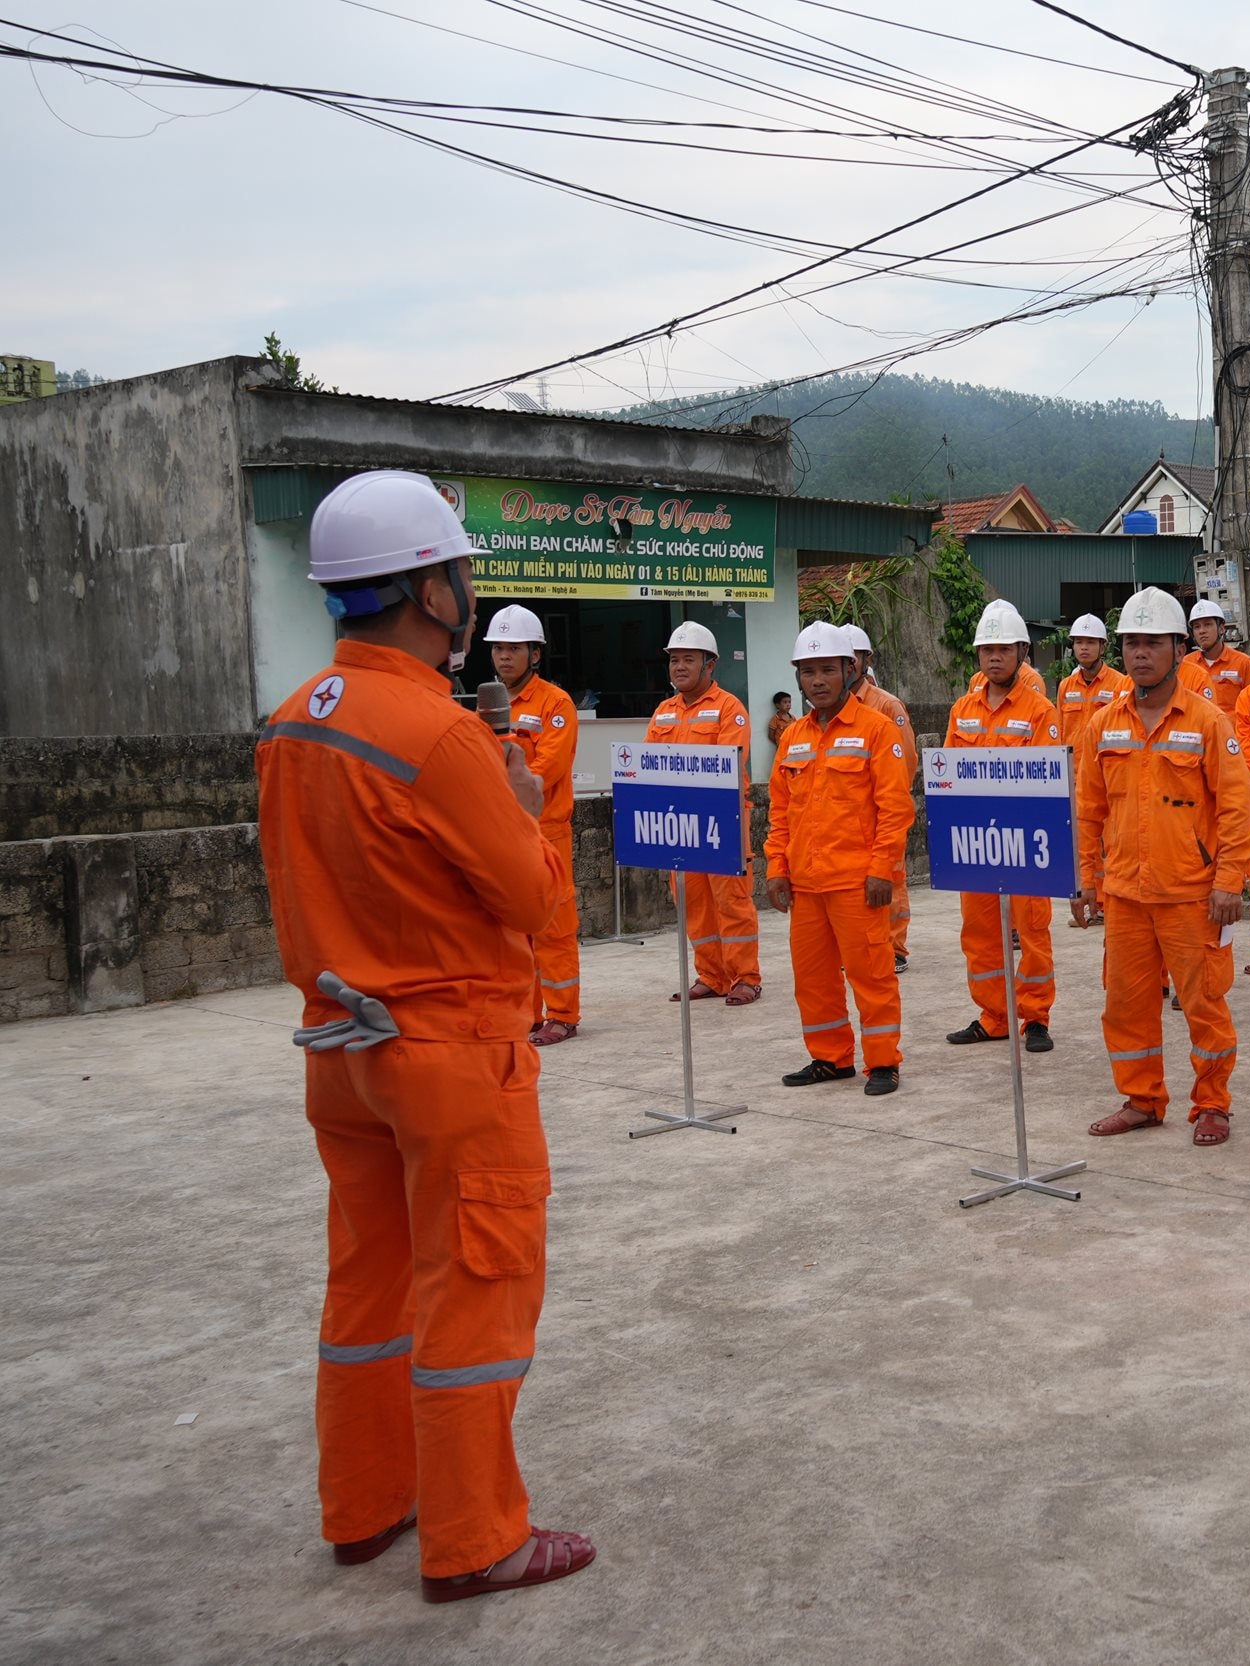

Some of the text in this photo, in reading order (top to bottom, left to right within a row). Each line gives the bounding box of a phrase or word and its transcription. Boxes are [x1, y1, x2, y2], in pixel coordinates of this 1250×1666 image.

[501, 488, 732, 535] Dược Sĩ Tâm Nguyễn
[490, 530, 527, 550] ĐÌNH
[530, 536, 560, 554] BẠN
[564, 535, 603, 553] CHĂM
[637, 537, 663, 556] SỨC
[666, 539, 700, 557] KHỎE
[702, 540, 727, 558] CHỦ
[730, 542, 764, 562] ĐỘNG
[489, 560, 520, 576] CHAY
[523, 556, 554, 577] MIỄN
[558, 560, 577, 578] PHÍ
[580, 560, 603, 578] VÀO
[606, 562, 635, 580] NGÀY
[638, 565, 650, 580] 01
[655, 565, 663, 580] &
[666, 566, 679, 581] 15
[682, 564, 702, 582] (ÂL)
[705, 565, 732, 582] HÀNG
[735, 566, 767, 583] THÁNG
[513, 586, 533, 594] Hoàng
[641, 752, 732, 776] CÔNG TY ĐIỆN LỰC NGHỆ AN
[957, 757, 1061, 783] CÔNG TY ĐIỆN LỰC NGHỆ AN
[928, 781, 952, 789] EVNNPC
[634, 805, 721, 850] NHÓM 4
[951, 818, 1050, 869] NHÓM 3
